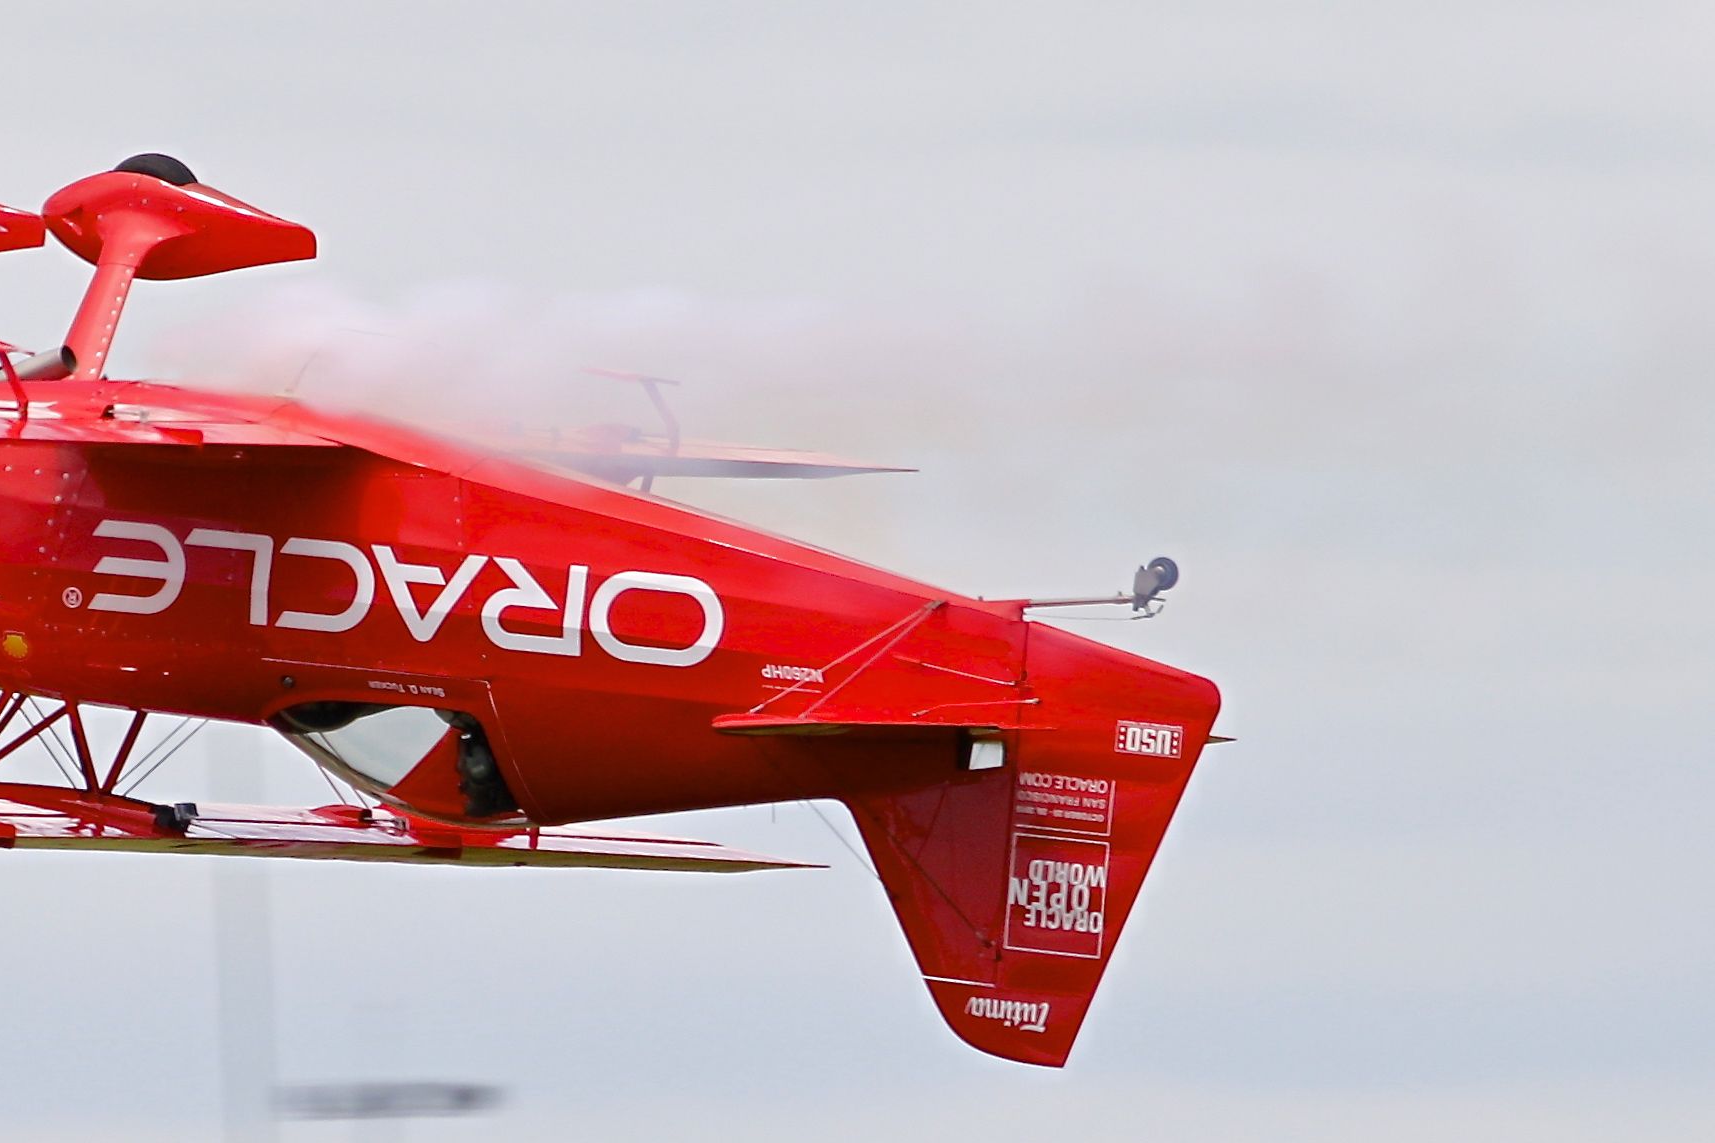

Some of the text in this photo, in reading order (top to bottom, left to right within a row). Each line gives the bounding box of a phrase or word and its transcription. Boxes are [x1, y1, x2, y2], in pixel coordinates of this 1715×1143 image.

[87, 519, 725, 667] ORACLE
[1124, 727, 1173, 756] USO
[1018, 772, 1109, 794] ORACLE.COM
[1082, 797, 1107, 810] SAN
[1028, 859, 1107, 888] WORLD
[1007, 876, 1090, 911] OPEN
[1023, 904, 1104, 934] ORACLE
[964, 996, 1050, 1034] Tutima
